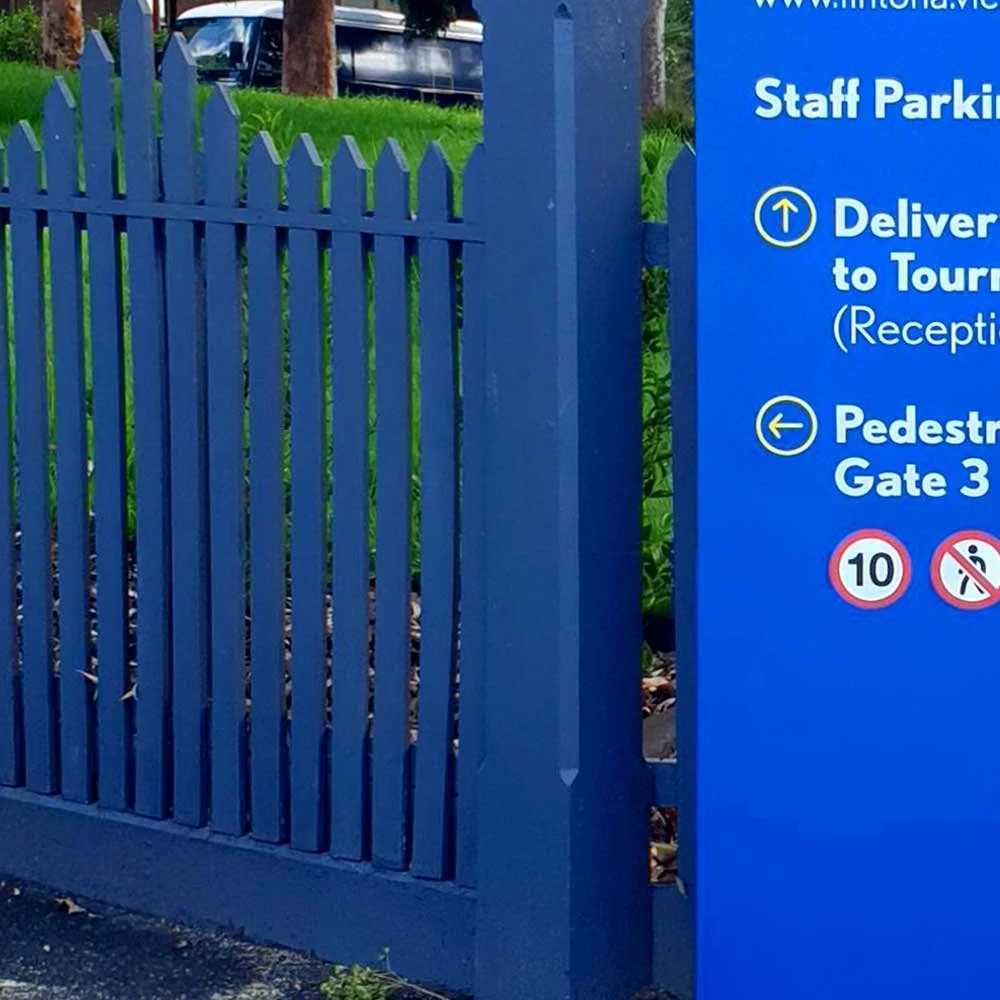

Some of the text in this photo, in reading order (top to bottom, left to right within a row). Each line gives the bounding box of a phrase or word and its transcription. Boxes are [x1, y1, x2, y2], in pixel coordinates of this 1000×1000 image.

[755, 77, 860, 119] Staff
[832, 258, 877, 291] to
[834, 457, 989, 497] Gate 3
[846, 551, 895, 588] 10
